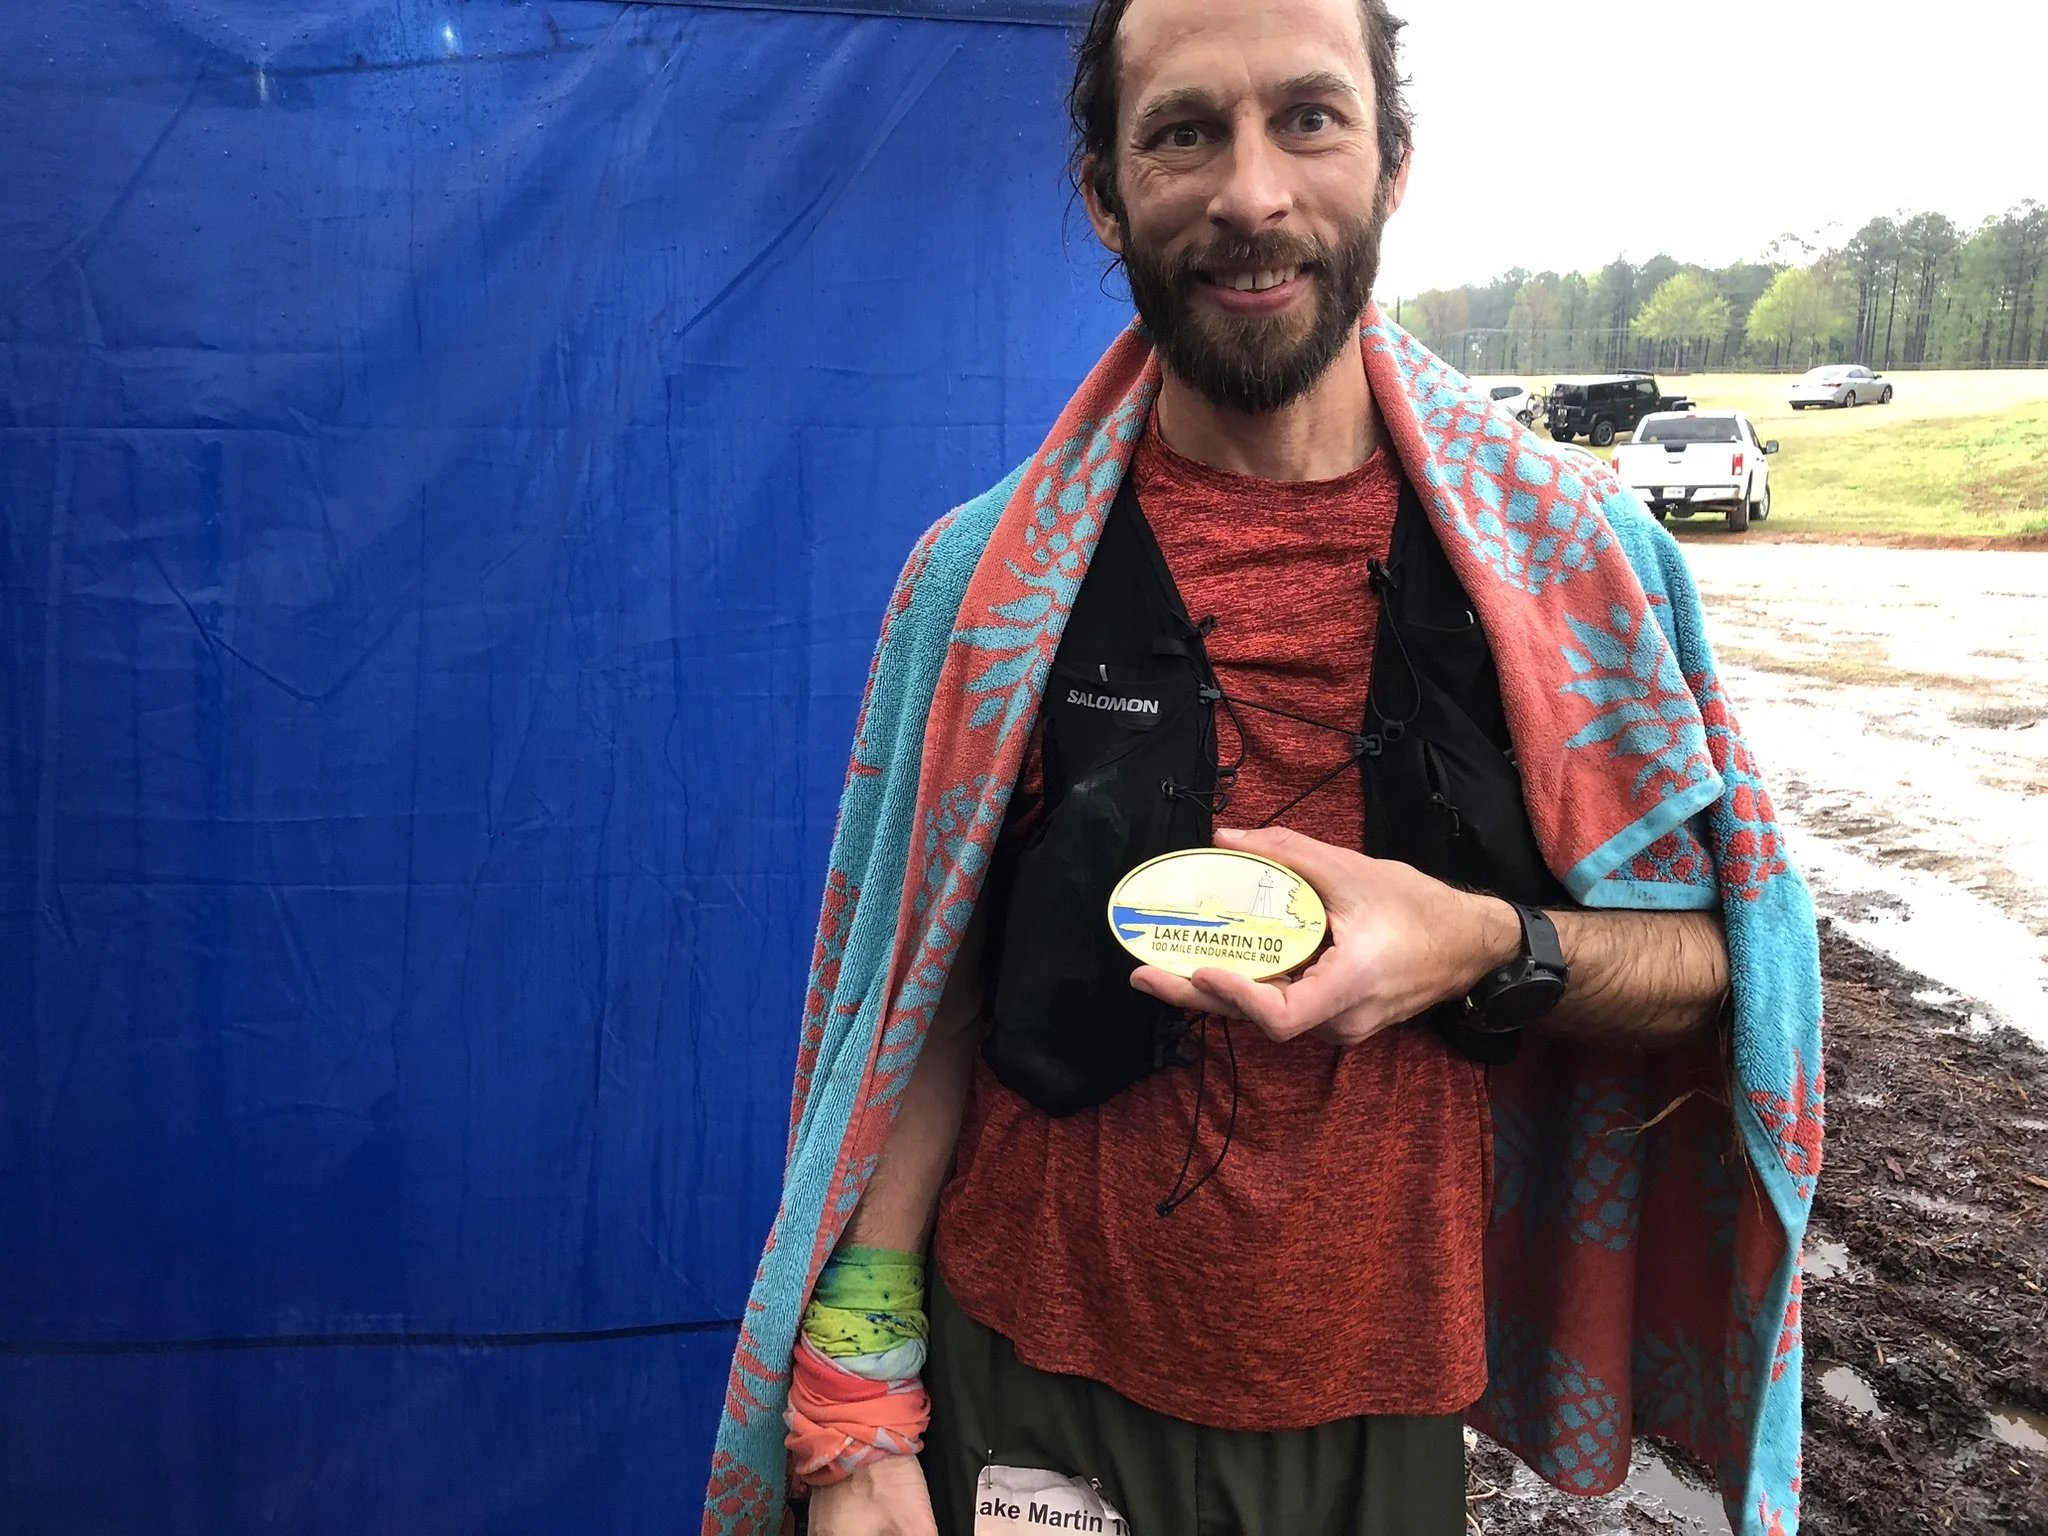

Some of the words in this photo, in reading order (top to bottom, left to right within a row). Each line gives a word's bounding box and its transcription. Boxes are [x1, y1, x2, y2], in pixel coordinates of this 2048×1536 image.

[1067, 689, 1159, 714] SALOMON
[1151, 941, 1168, 952] 100
[1170, 943, 1192, 954] MILE
[1194, 945, 1257, 961] ENDURANCE
[1259, 953, 1281, 964] RUN
[1154, 926, 1190, 942] LAKE
[1193, 930, 1253, 949] MARTIN
[1258, 936, 1283, 953] 100
[976, 1498, 1021, 1520] ake
[1028, 1502, 1103, 1533] Martin
